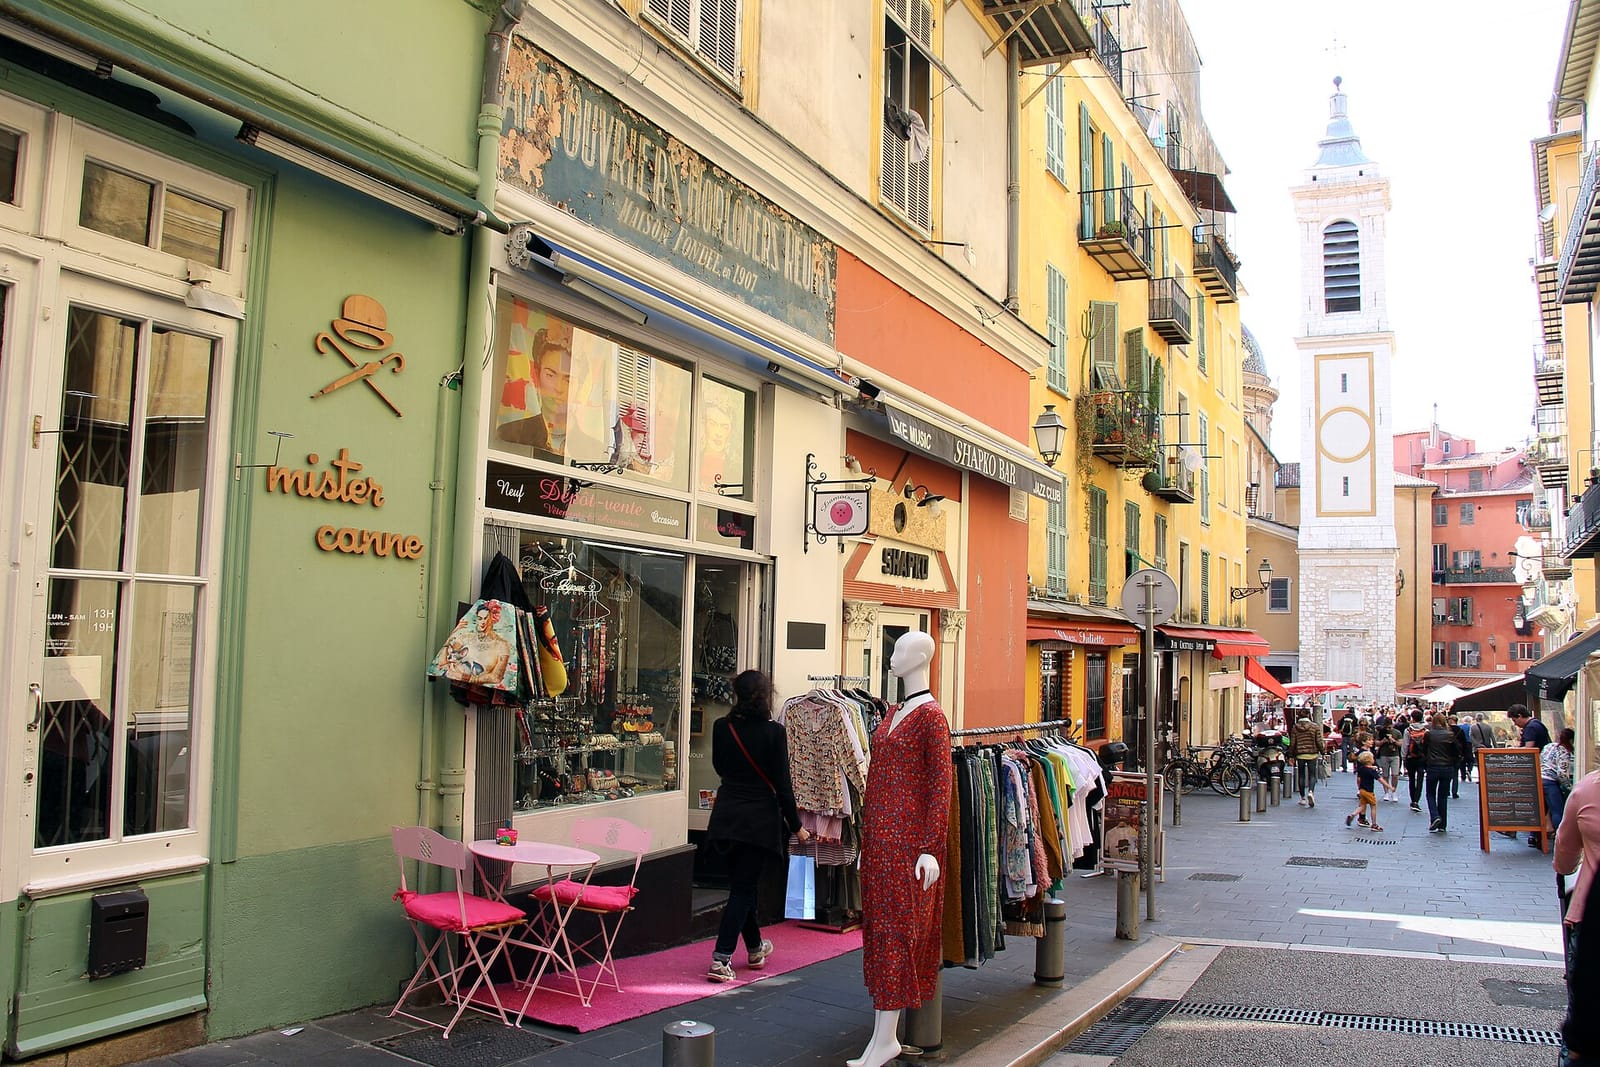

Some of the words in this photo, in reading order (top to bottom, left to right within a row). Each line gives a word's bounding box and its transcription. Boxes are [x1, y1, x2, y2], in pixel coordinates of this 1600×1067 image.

[686, 157, 780, 272] HORLOGERS
[733, 263, 758, 293] 1907
[909, 425, 932, 450] MUSIC
[953, 440, 997, 477] SHAPKO
[999, 457, 1017, 486] BAR
[266, 447, 386, 508] mister
[496, 479, 525, 504] Neuf
[1033, 481, 1045, 498] JAZZ
[1046, 486, 1061, 503] CLUB
[650, 510, 680, 528] Occasion
[315, 523, 425, 560] canne
[881, 547, 930, 581] SHAPKO
[94, 609, 114, 619] 13H
[93, 622, 113, 632] 19H
[1078, 631, 1105, 645] Juliette
